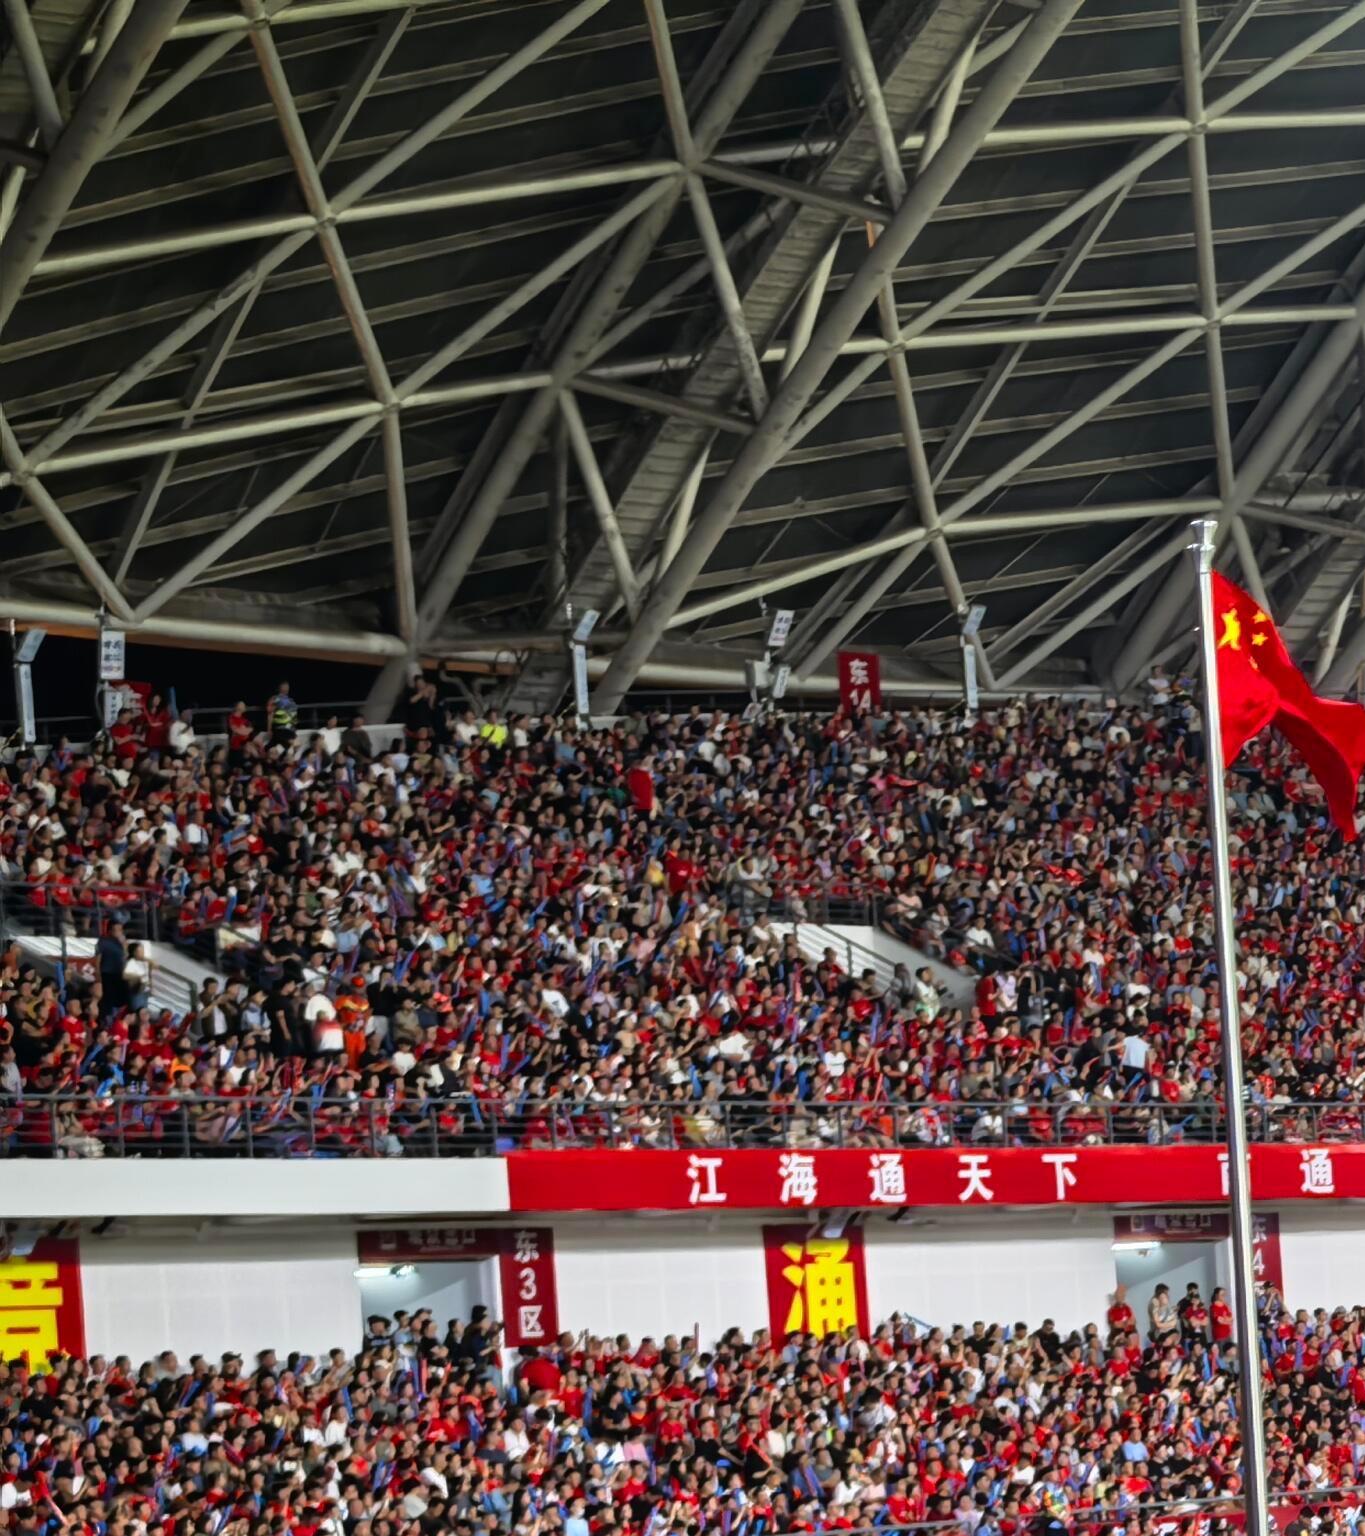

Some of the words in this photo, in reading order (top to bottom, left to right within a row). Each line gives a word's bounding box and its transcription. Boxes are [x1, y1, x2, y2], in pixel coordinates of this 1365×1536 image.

[686, 1153, 1078, 1205] 江海通天下
[513, 1229, 545, 1339] 东3区
